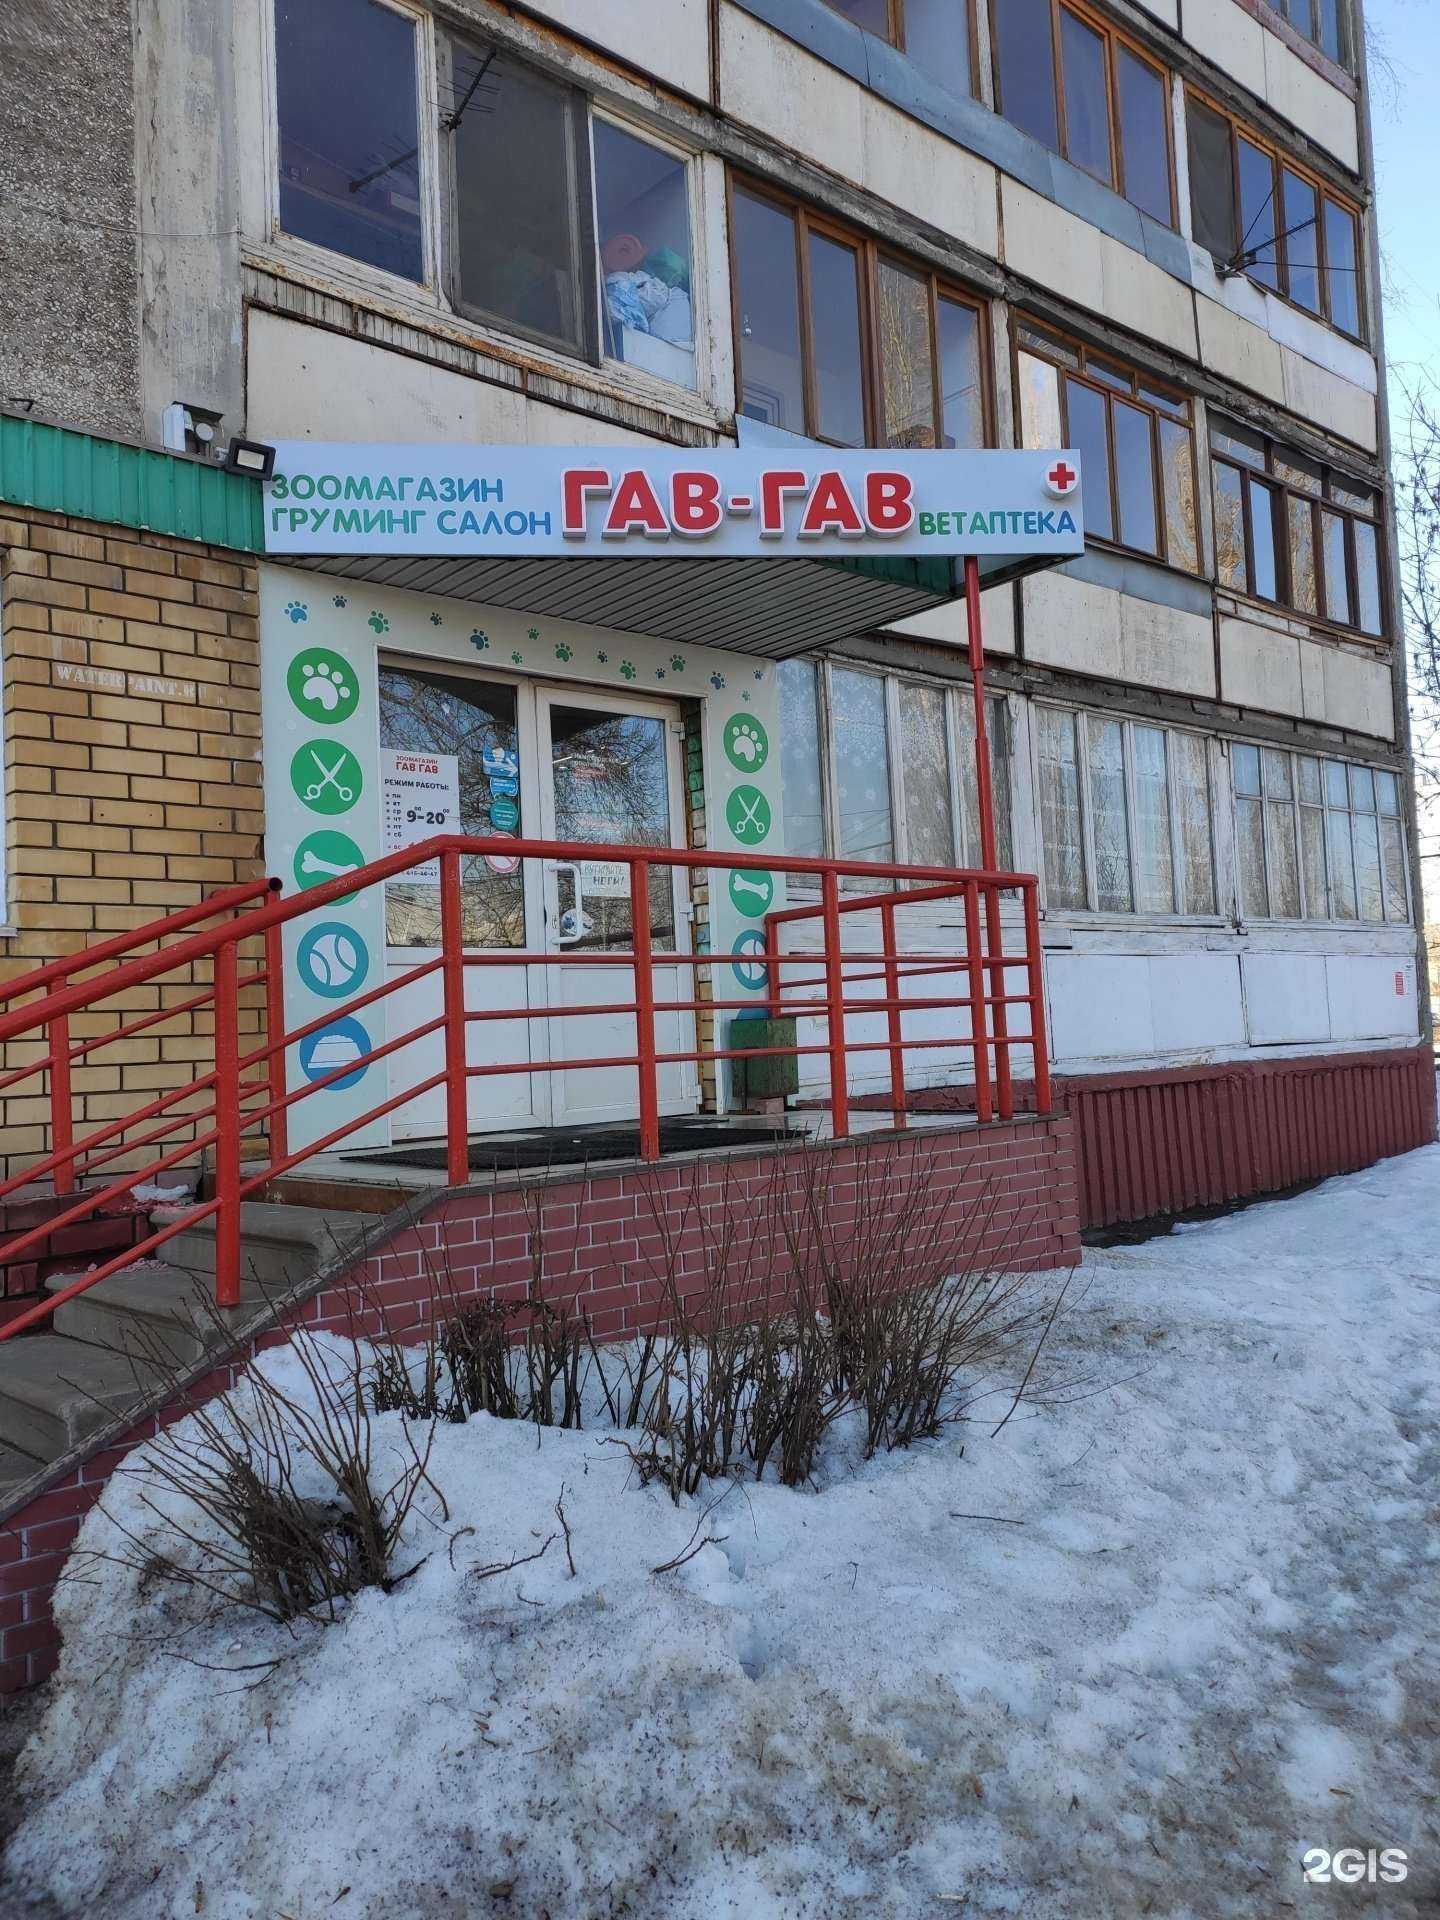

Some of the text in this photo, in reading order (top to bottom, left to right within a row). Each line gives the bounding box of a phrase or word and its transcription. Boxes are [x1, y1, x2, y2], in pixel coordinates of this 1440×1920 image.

[271, 473, 503, 503] ЗООМАГАЗИН
[562, 469, 915, 539] ГАВ-ГАВ
[271, 508, 551, 535] ГРУМИНГ САЛОН
[919, 510, 1076, 535] ВЕТАПТЕКА
[396, 762, 438, 774] ГАВ ГАВ
[384, 779, 449, 790] РЕЖИМ РАБОТЫ:
